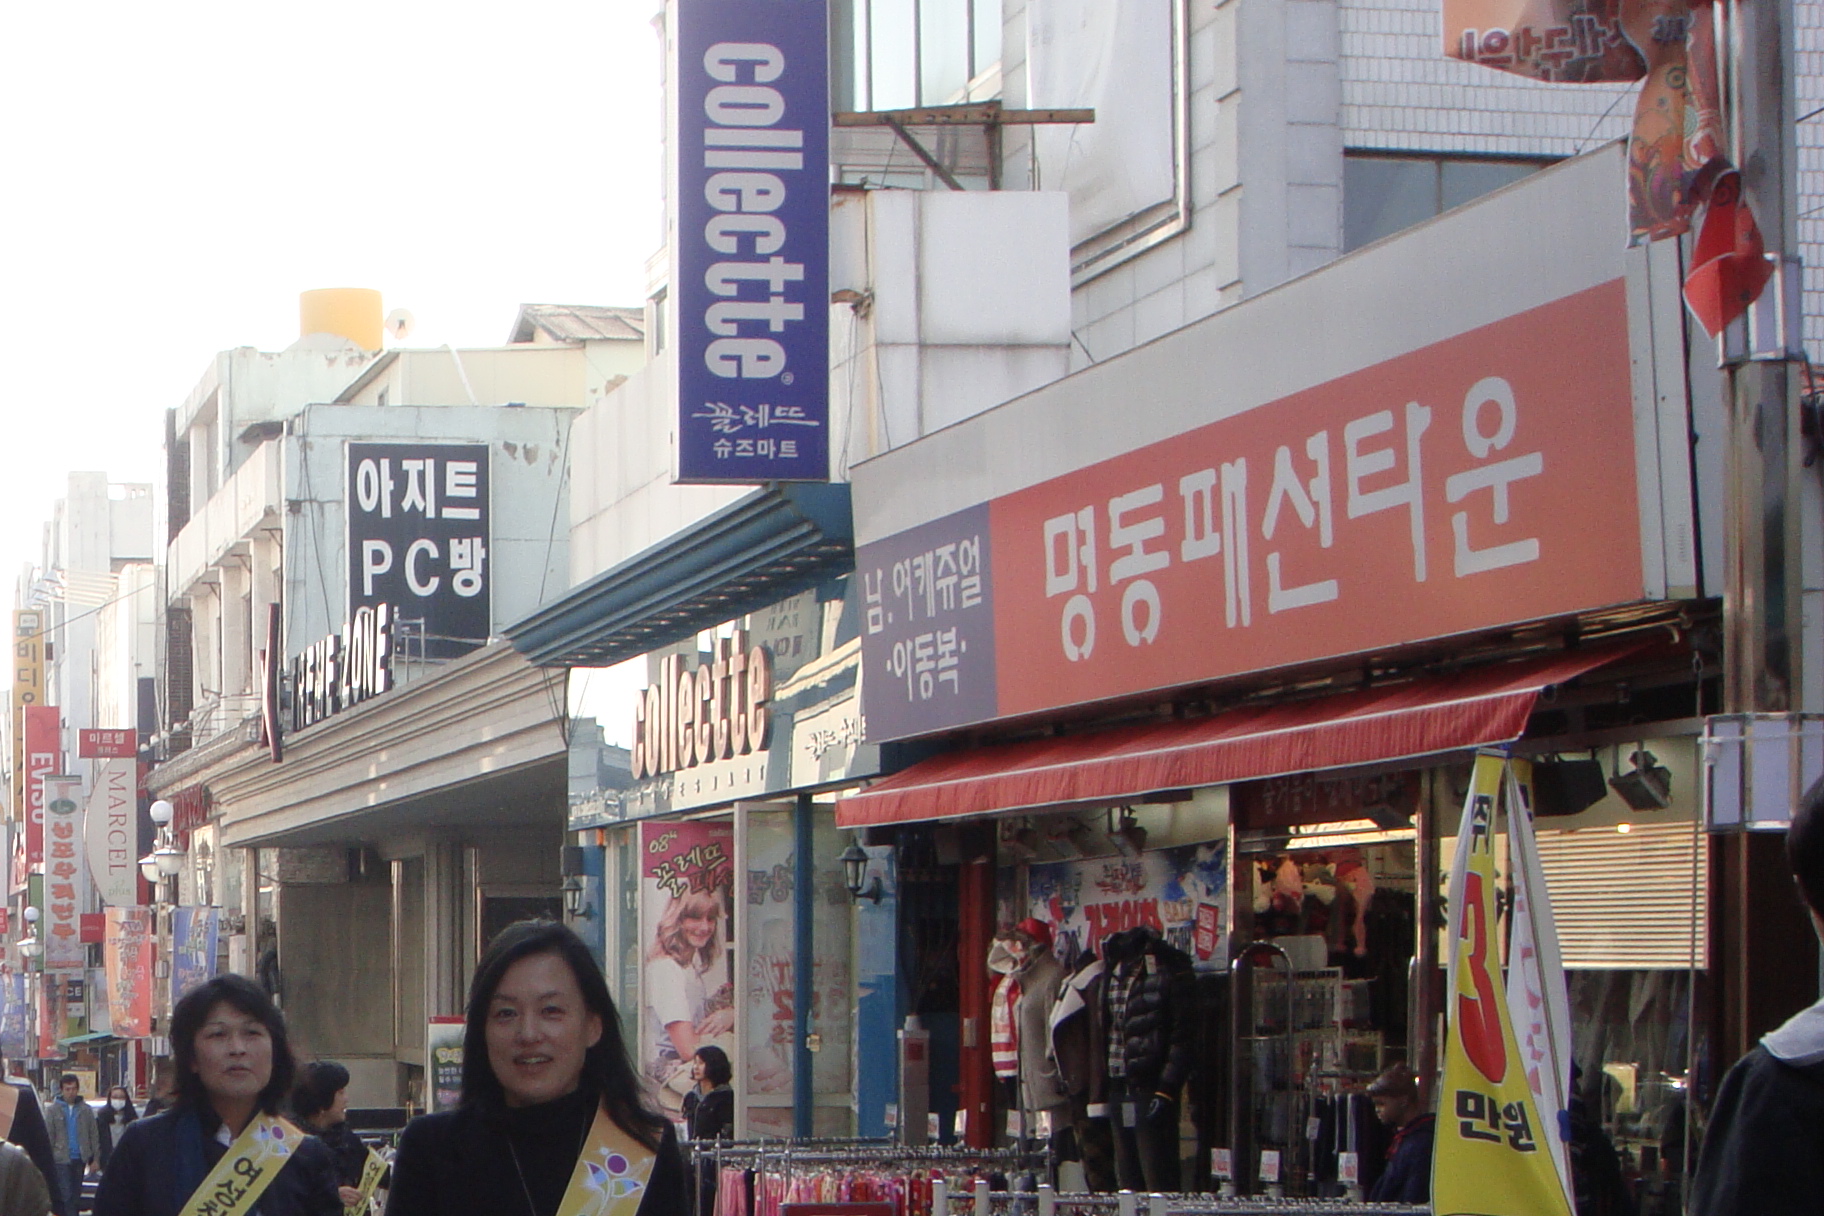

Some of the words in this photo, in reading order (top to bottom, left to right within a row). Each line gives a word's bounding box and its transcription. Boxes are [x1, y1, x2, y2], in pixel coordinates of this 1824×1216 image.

[703, 42, 805, 380] collette
[355, 457, 481, 520] 아지트
[712, 438, 799, 460] 슈즈마트
[1044, 375, 1545, 663] 명동패션타운
[630, 629, 772, 780] collette
[107, 769, 128, 877] MARCEL
[1455, 1089, 1537, 1154] 만원
